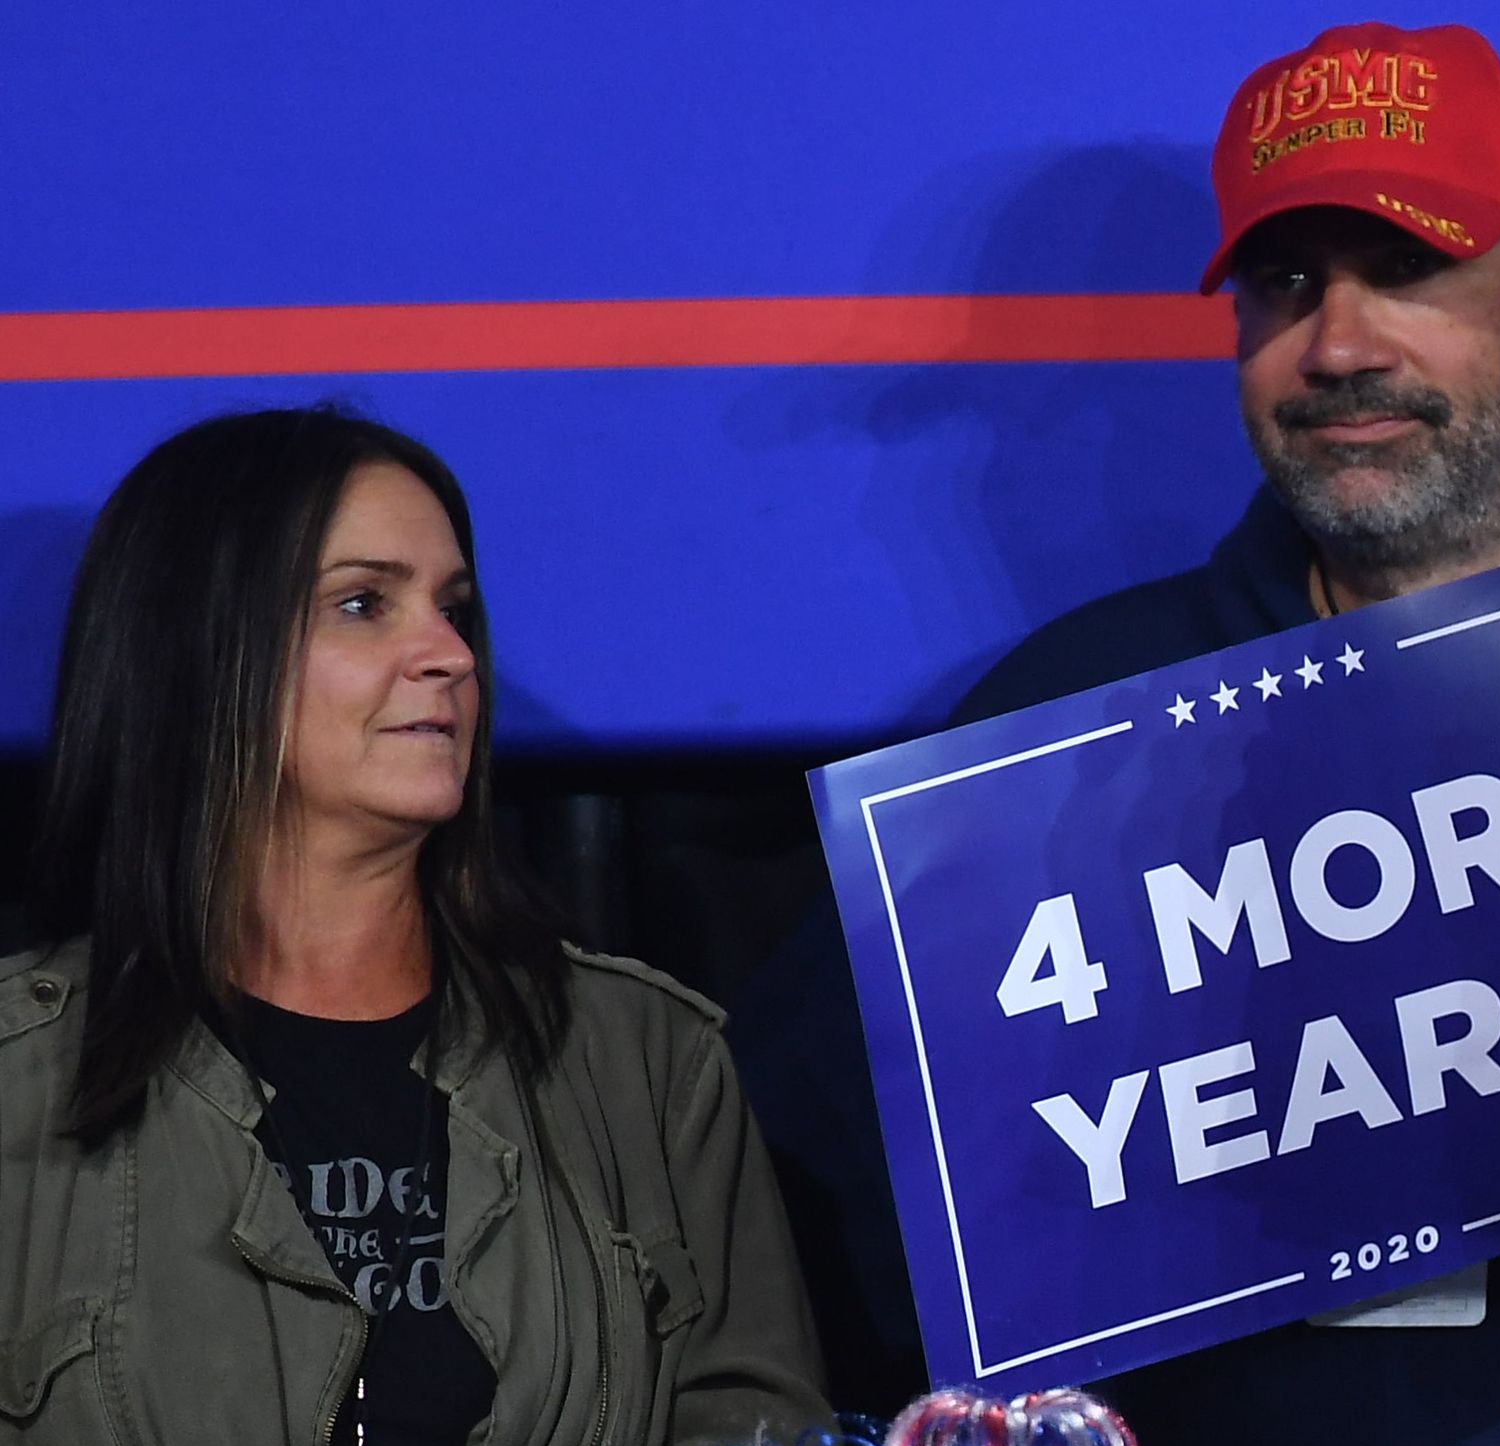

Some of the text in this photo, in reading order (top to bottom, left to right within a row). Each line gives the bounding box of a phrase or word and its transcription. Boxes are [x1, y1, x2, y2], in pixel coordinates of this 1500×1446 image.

[1247, 47, 1437, 143] USMC
[997, 893, 1109, 1025] 4
[1330, 1226, 1440, 1281] 2020
